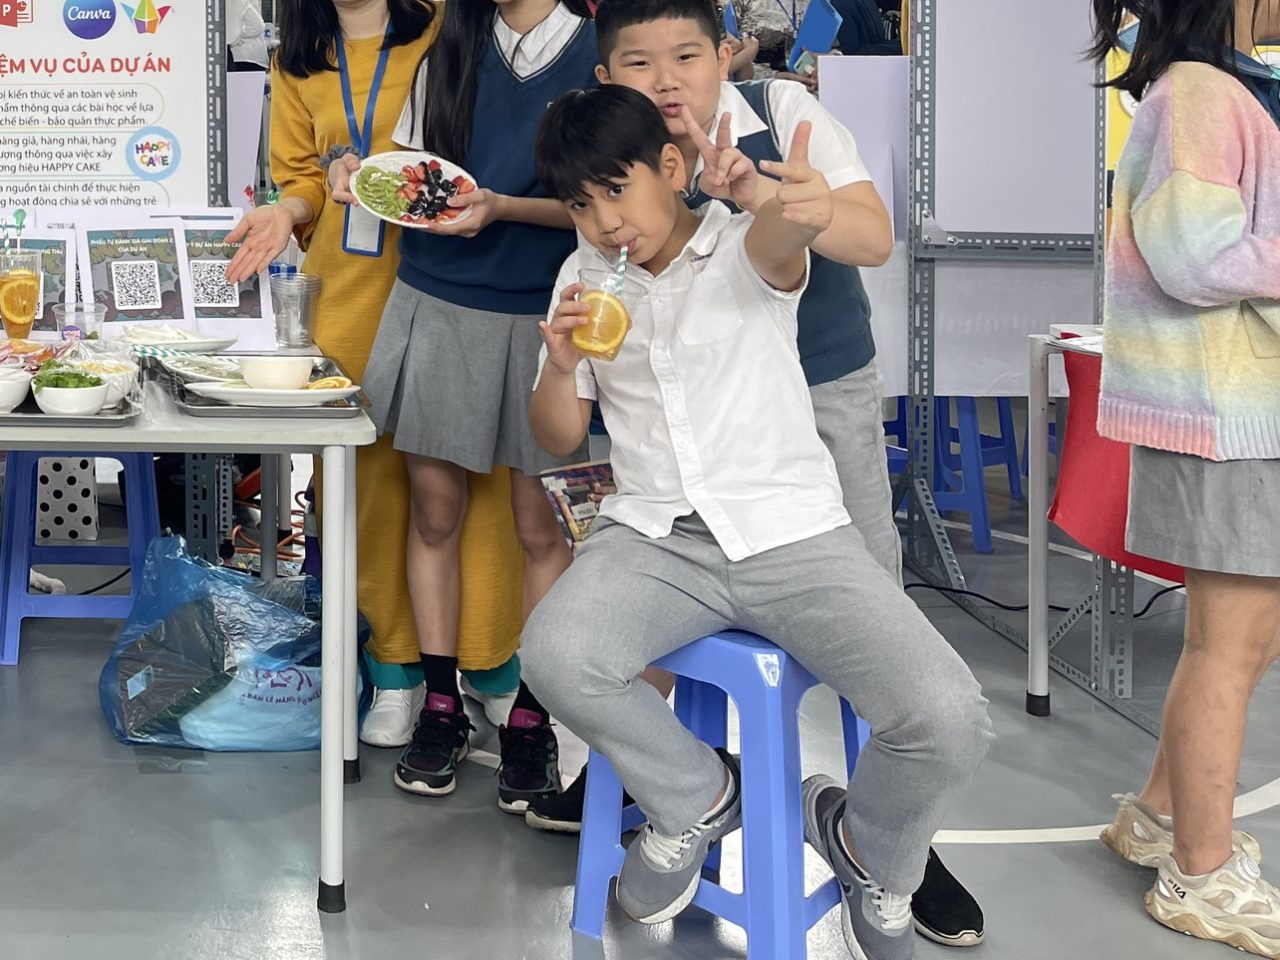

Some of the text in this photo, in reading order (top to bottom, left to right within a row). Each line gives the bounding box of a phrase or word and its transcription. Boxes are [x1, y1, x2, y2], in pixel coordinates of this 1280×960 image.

[2, 4, 11, 16] P
[68, 6, 112, 20] Canva
[30, 58, 57, 78] VỤ
[62, 51, 105, 74] CỦA
[111, 56, 141, 78] DỰ
[144, 52, 170, 73] ÁN
[136, 140, 171, 154] HAPPY
[18, 162, 40, 172] hiệu
[42, 162, 73, 172] HAPPY
[76, 162, 101, 172] CAKE
[140, 154, 170, 168] CAKE
